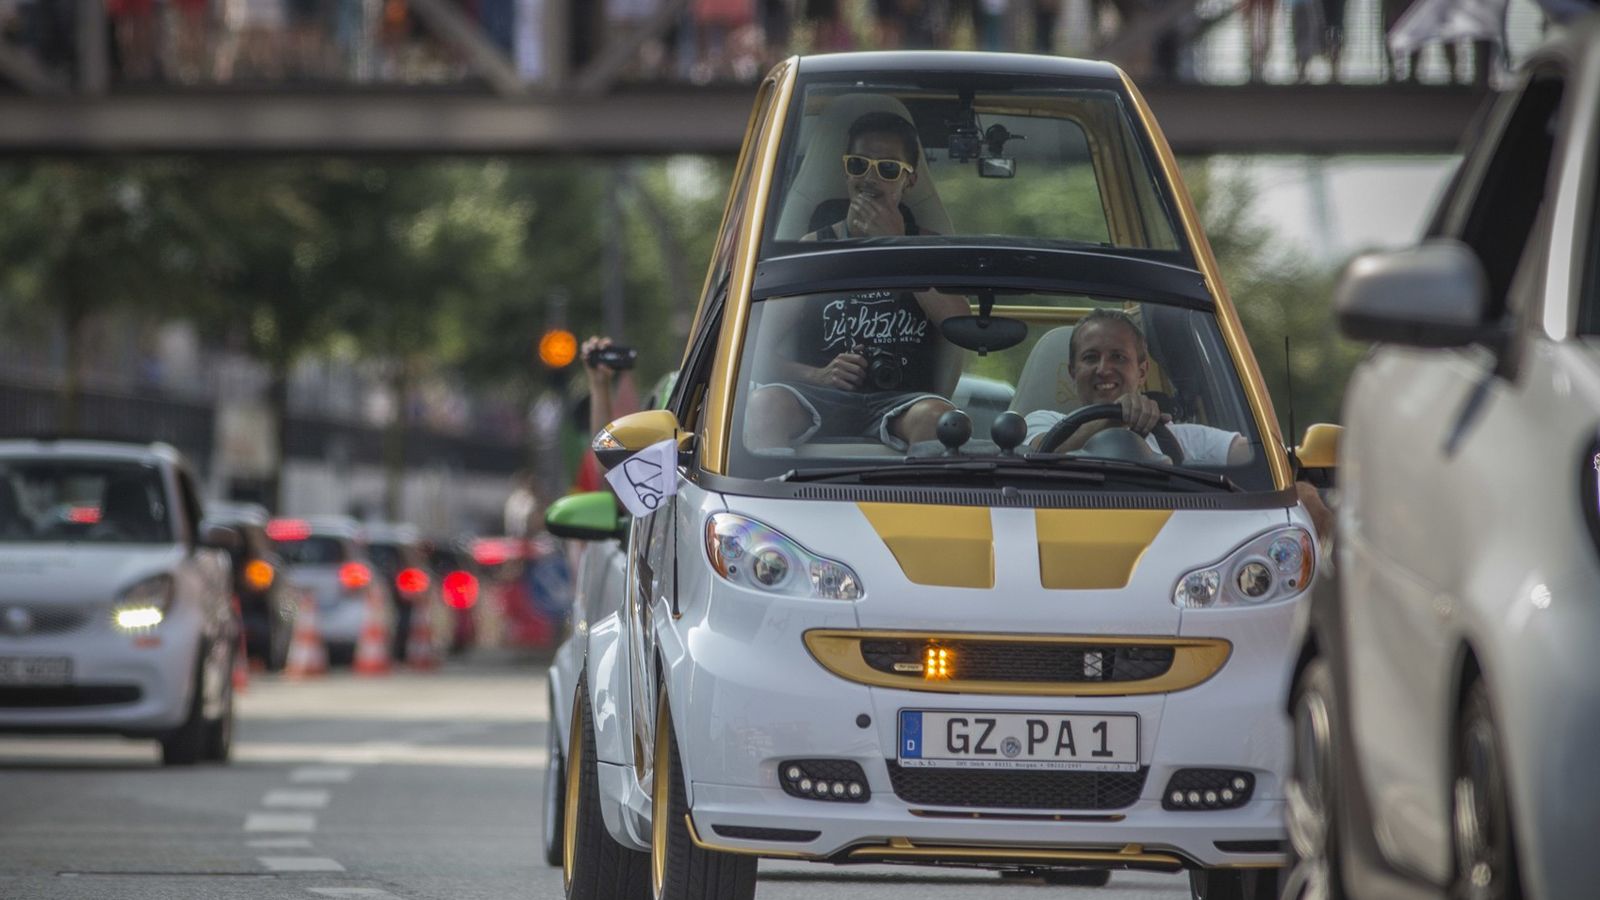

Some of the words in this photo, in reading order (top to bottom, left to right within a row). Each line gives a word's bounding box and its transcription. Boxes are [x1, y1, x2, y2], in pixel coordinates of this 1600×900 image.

[907, 740, 915, 751] D
[946, 718, 997, 755] GZ
[1026, 719, 1077, 757] PA
[1091, 720, 1113, 757] 1
